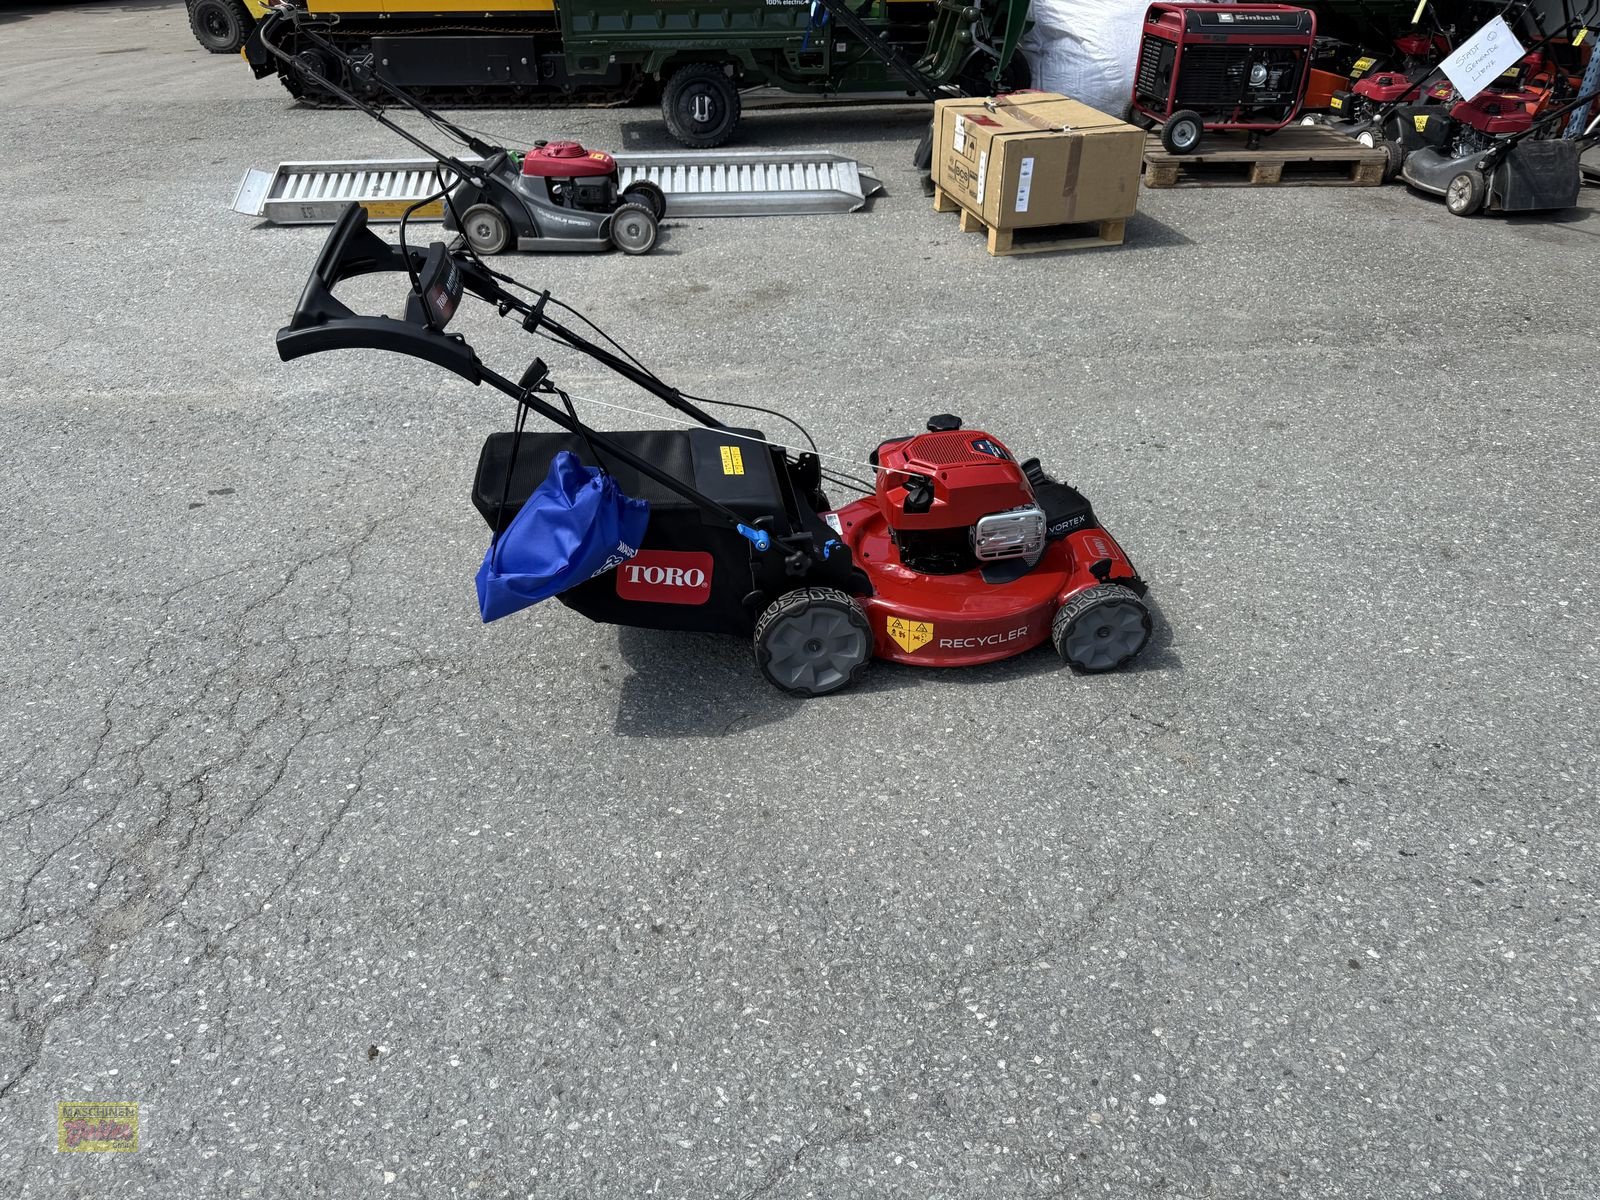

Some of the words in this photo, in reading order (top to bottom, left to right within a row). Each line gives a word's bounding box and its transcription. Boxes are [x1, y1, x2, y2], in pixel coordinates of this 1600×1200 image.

[1456, 43, 1480, 67] STADT
[1048, 514, 1085, 533] VORTEX
[625, 565, 705, 587] TORO
[939, 626, 1028, 649] RECYCLER
